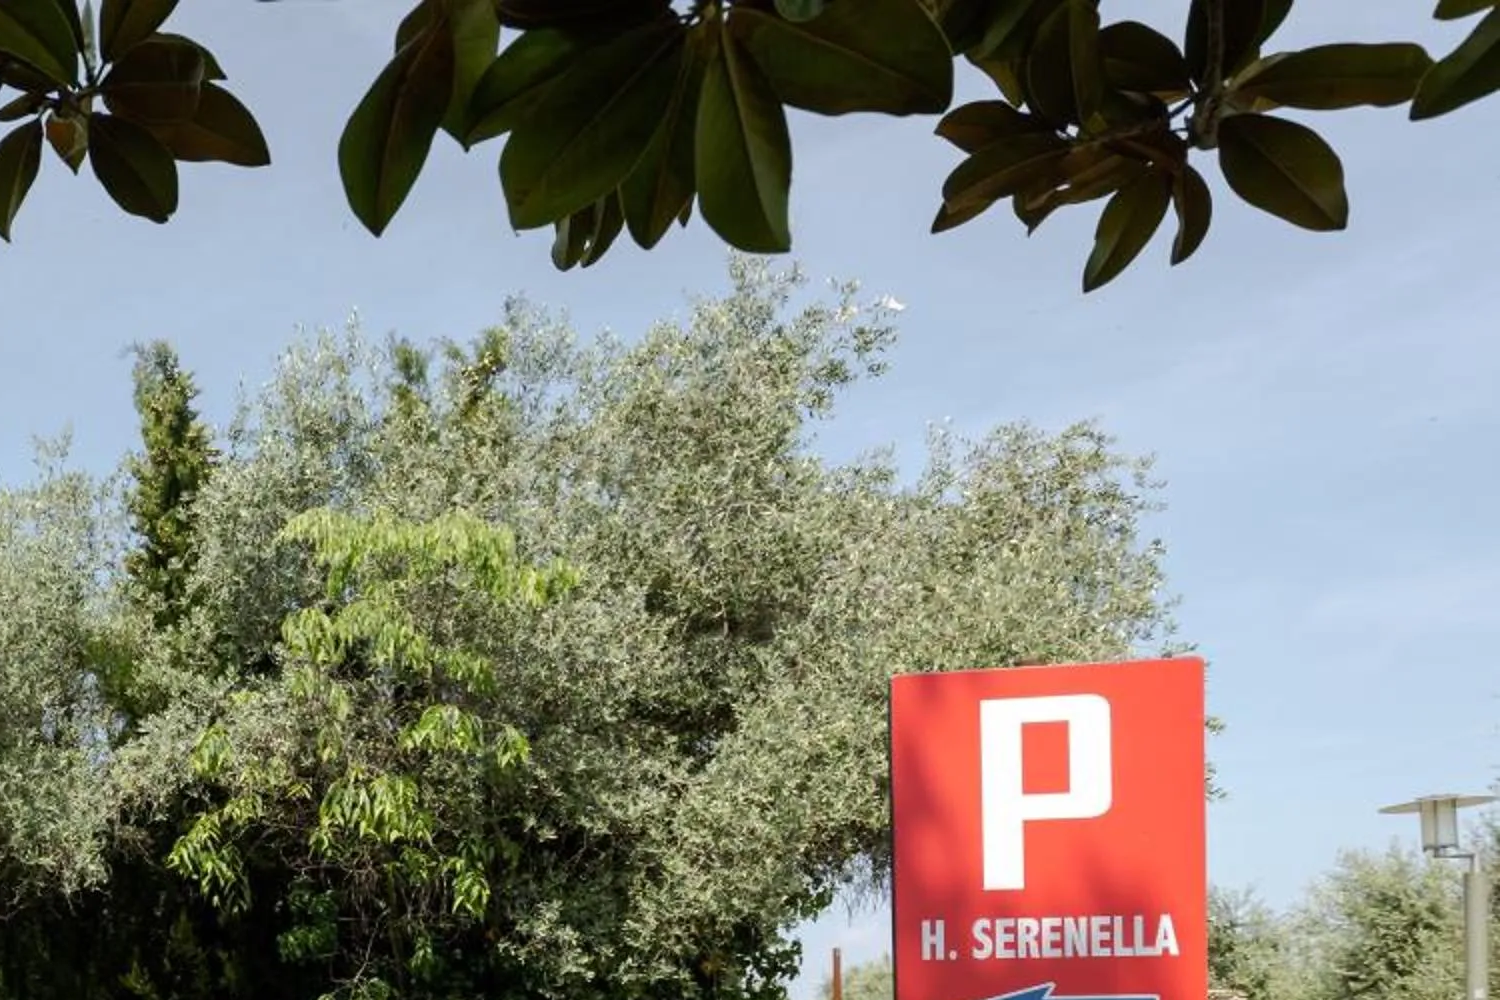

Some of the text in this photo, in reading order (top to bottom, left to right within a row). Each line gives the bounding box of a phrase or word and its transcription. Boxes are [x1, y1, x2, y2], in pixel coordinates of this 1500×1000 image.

[980, 694, 1112, 890] P
[921, 913, 1180, 960] H. SERENELLA
